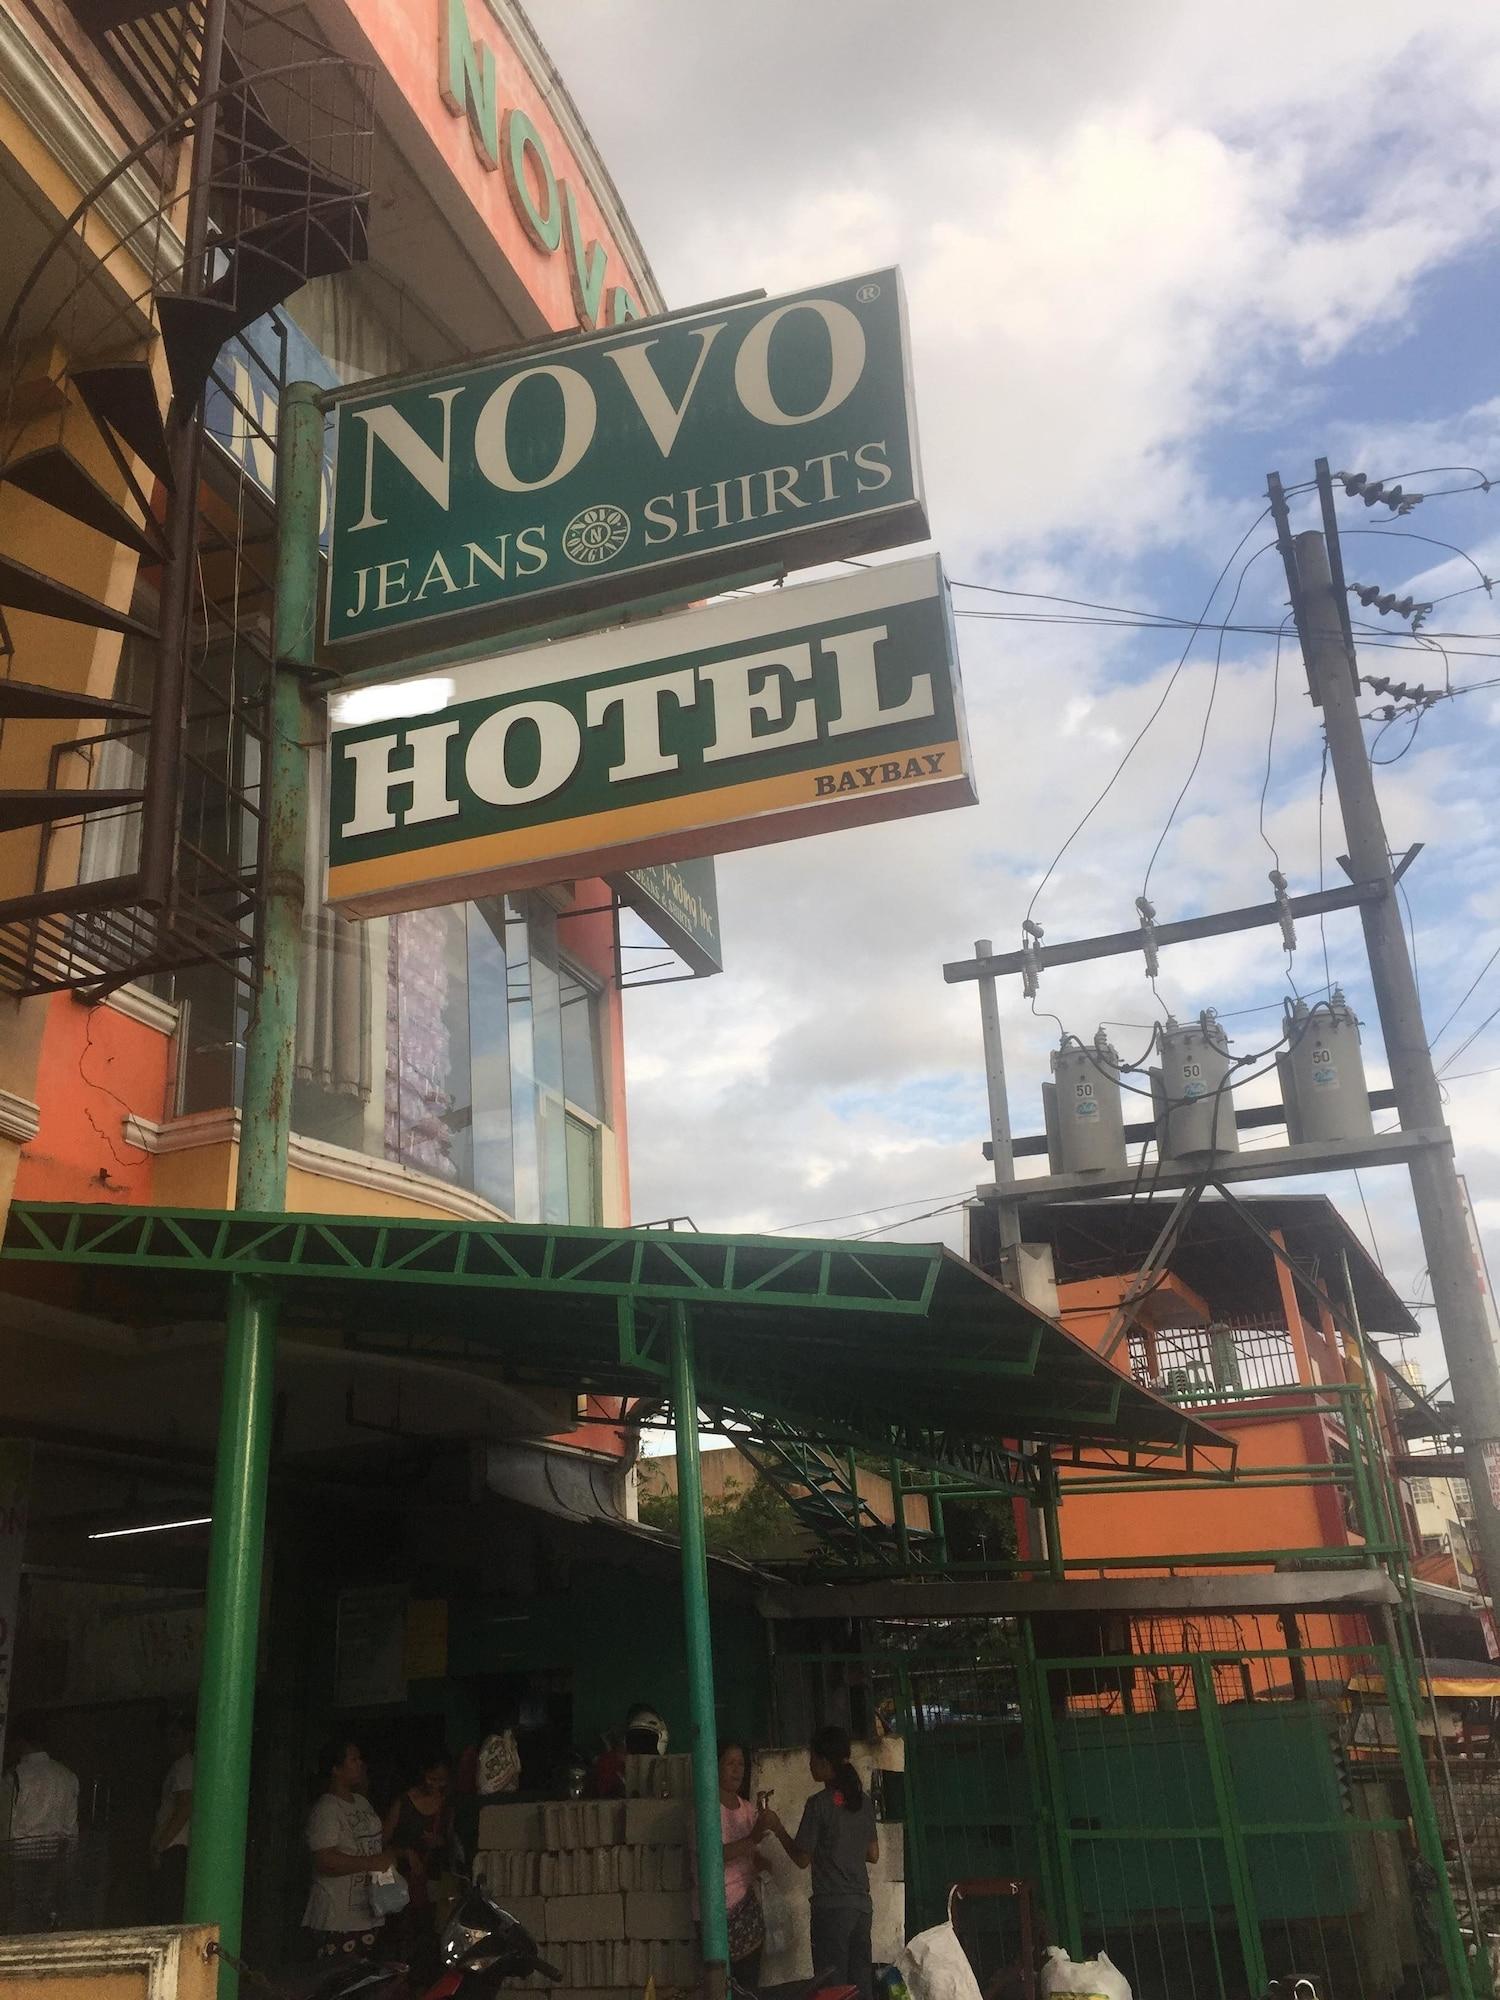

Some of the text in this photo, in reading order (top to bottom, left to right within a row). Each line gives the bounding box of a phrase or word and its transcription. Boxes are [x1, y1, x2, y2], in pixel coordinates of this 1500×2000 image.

[347, 297, 867, 534] NOVO
[345, 440, 894, 619] JEANS SHIRTS
[341, 624, 936, 840] HOTEL
[814, 751, 946, 797] BAYBAY
[1183, 1064, 1200, 1078] 50
[1312, 1050, 1330, 1064] 50
[1076, 1084, 1092, 1097] 50
